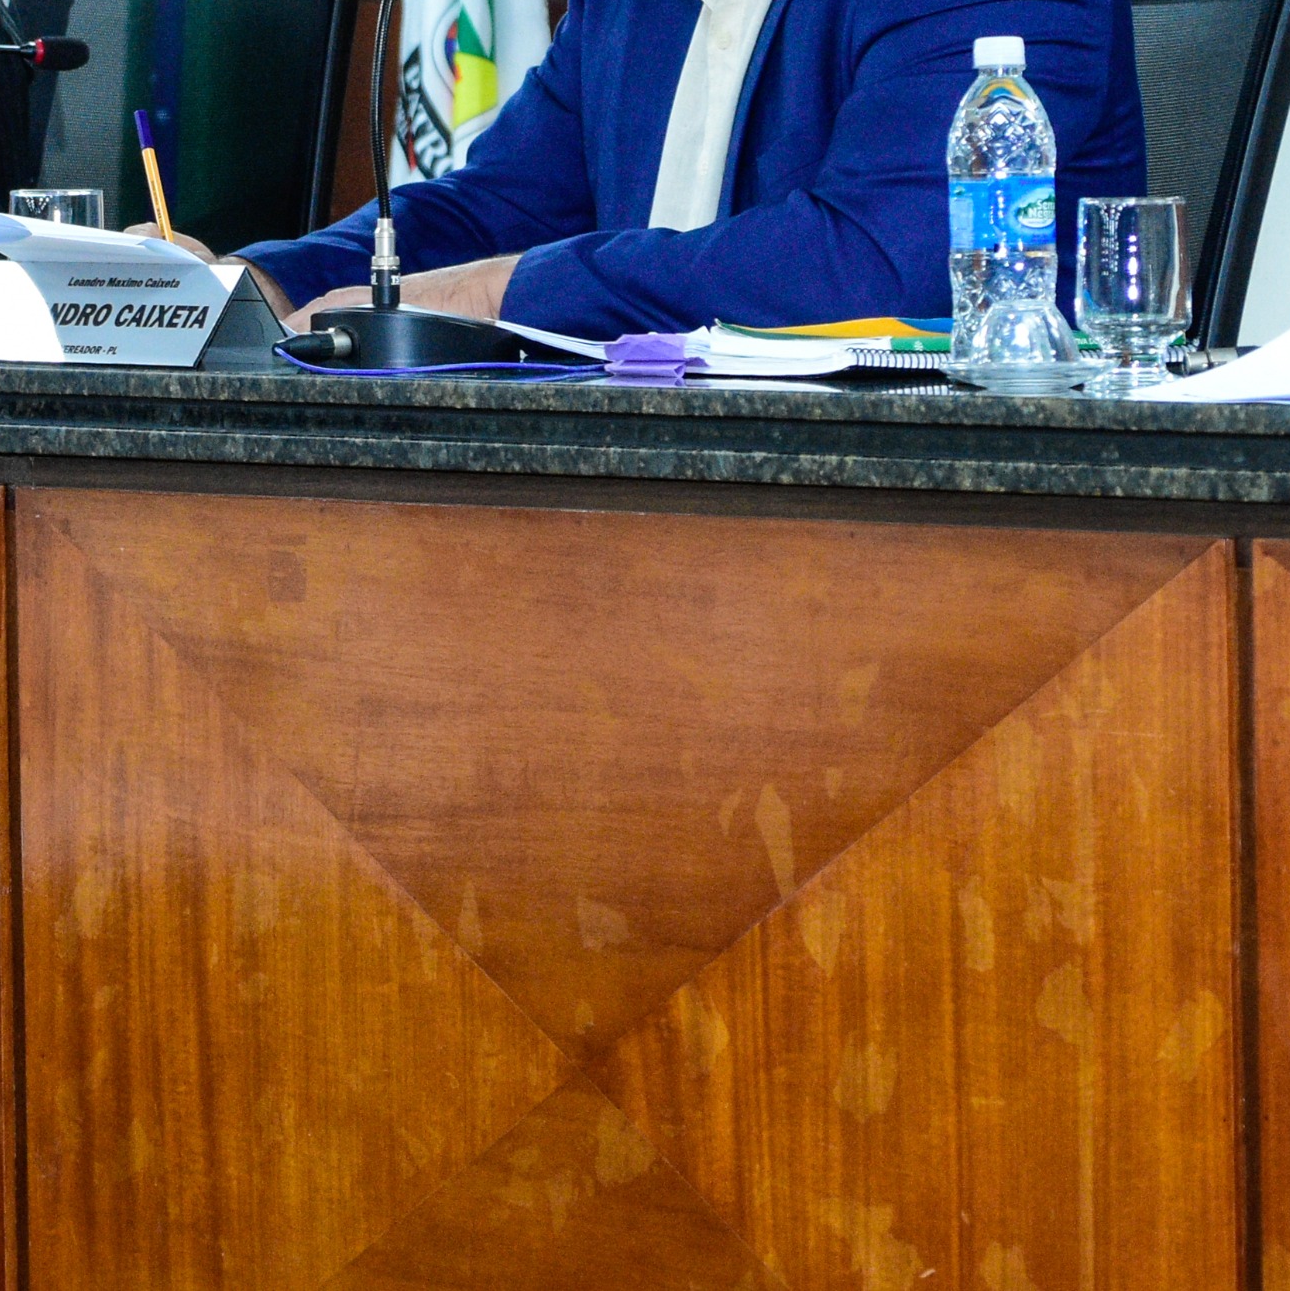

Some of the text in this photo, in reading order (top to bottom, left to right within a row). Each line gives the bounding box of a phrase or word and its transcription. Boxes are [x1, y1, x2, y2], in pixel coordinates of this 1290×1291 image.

[67, 276, 181, 289] Leandro Maximo Caixeta
[50, 302, 210, 329] NDRO CAIXETA
[62, 345, 103, 355] EREADOR
[106, 345, 118, 355] PL
